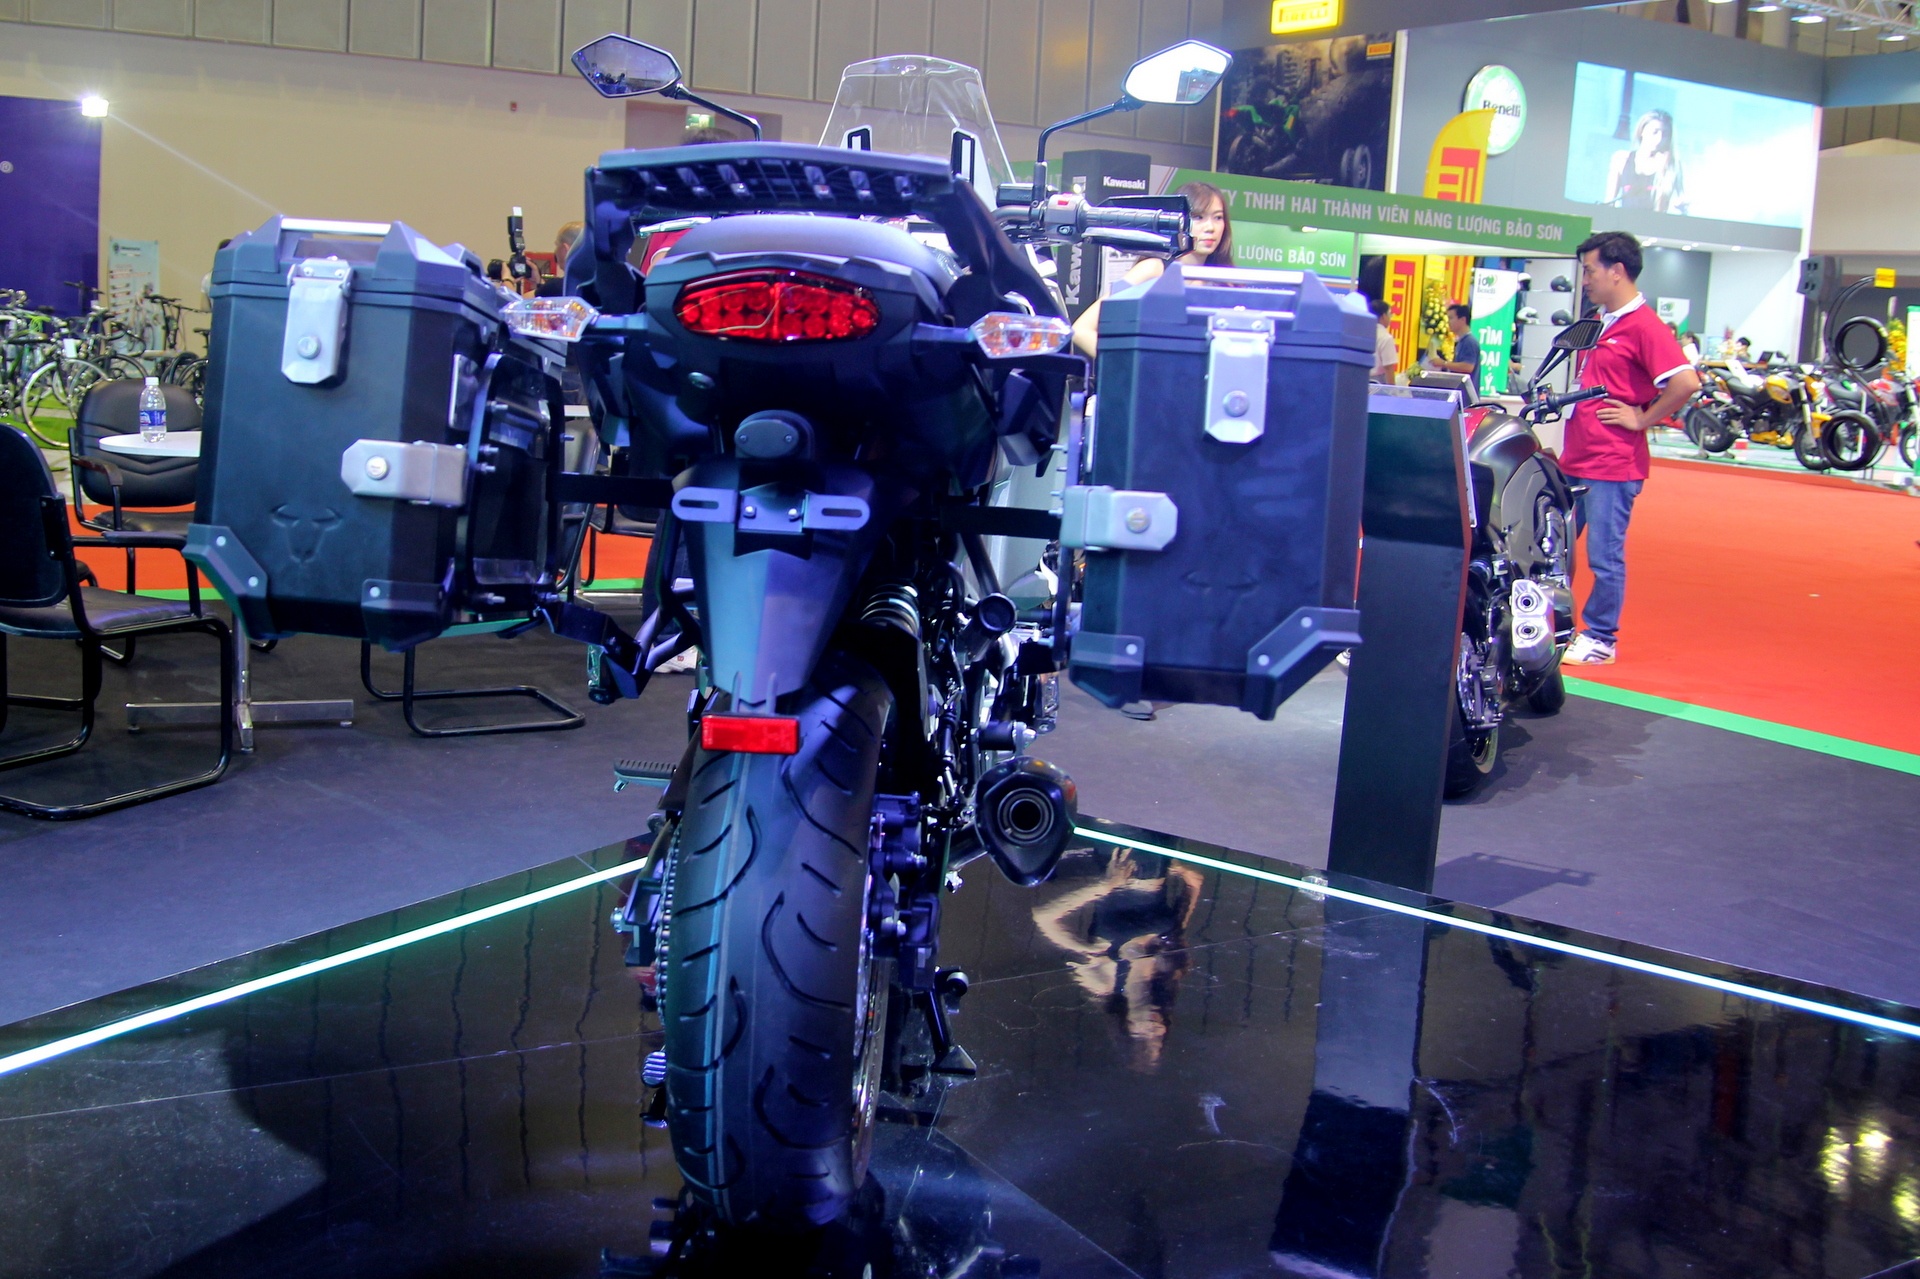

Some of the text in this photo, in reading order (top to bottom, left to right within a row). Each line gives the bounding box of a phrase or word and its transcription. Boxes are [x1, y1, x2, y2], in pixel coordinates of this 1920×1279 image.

[1103, 176, 1146, 190] Kawasaki
[1243, 191, 1285, 212] TNHH
[1291, 196, 1317, 214] HAI
[1323, 198, 1371, 220] THÀNH
[1377, 204, 1409, 224] VIÊN
[1457, 214, 1501, 236] LƯỢNG
[1506, 217, 1532, 238] BẢO
[1536, 223, 1563, 241] SƠN
[1238, 244, 1346, 267] LƯỢNG BẢO SƠN
[1479, 326, 1503, 346] TÌM
